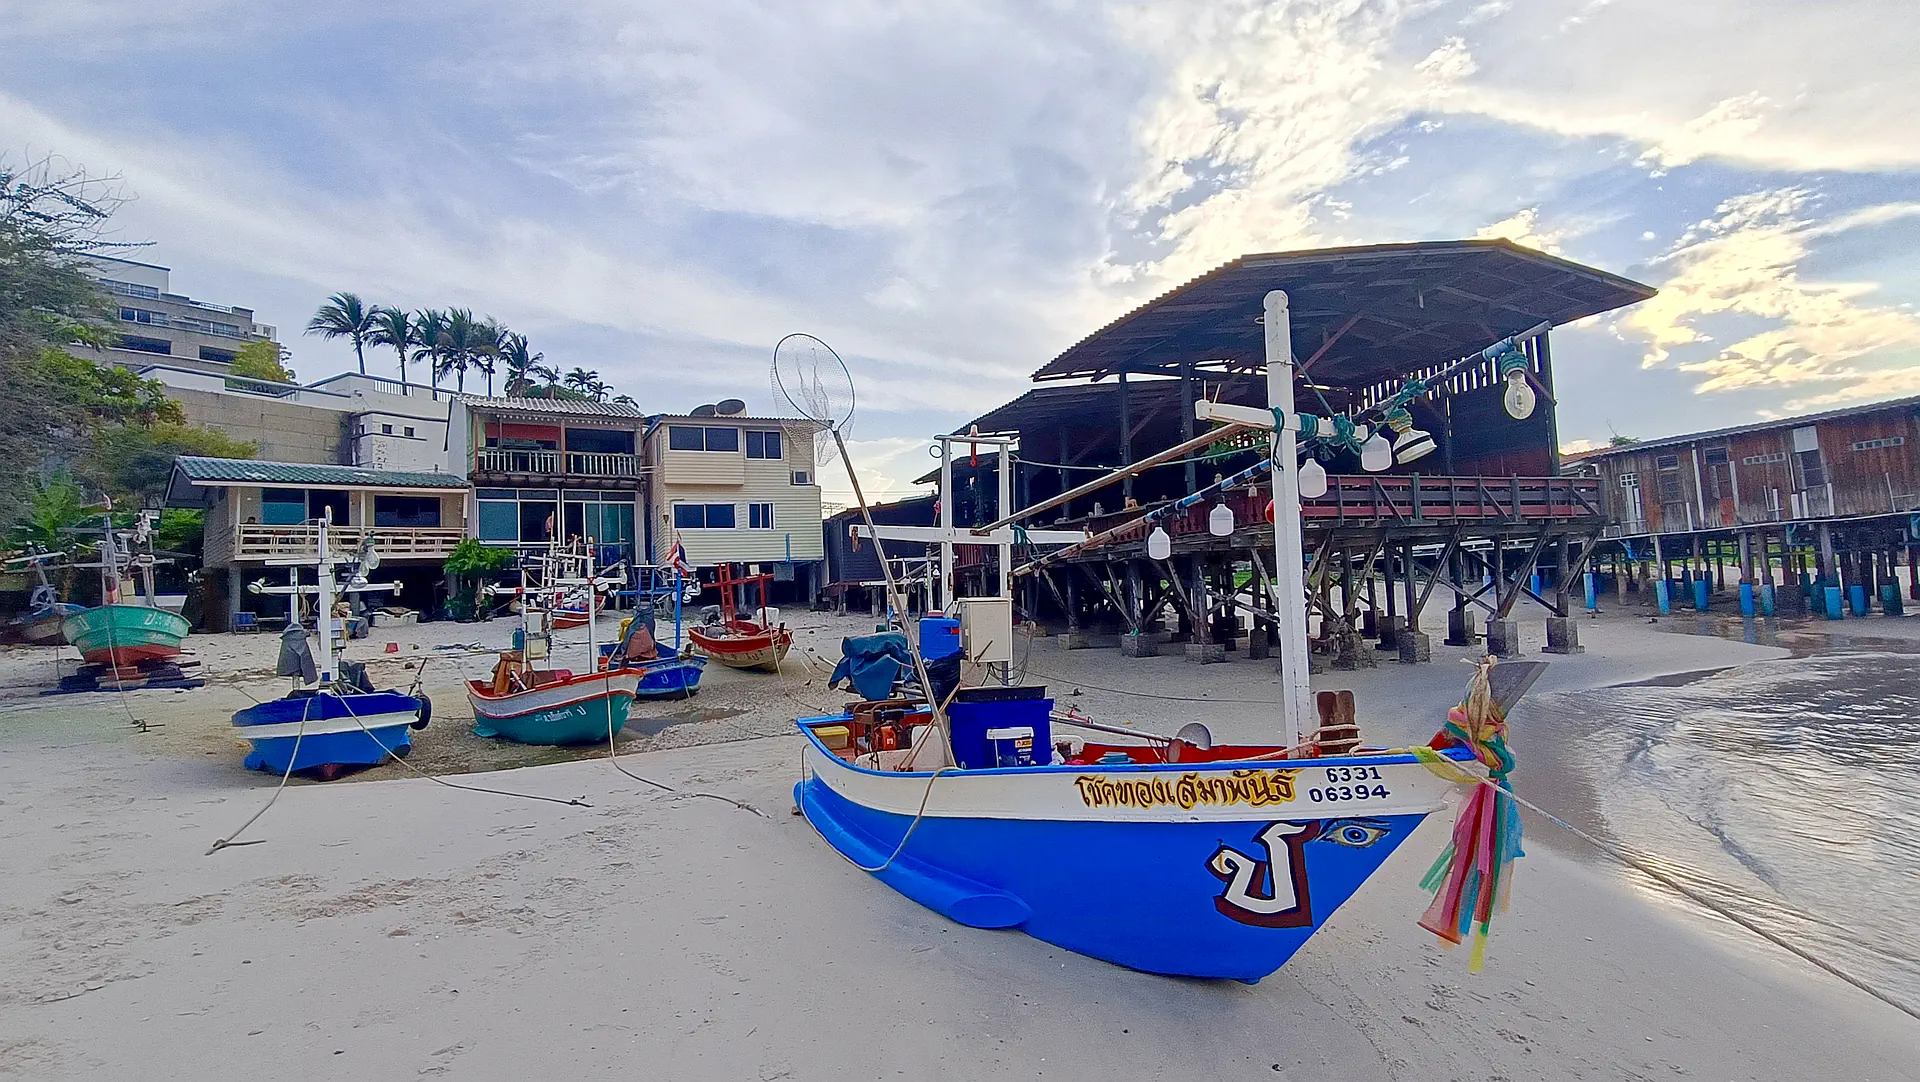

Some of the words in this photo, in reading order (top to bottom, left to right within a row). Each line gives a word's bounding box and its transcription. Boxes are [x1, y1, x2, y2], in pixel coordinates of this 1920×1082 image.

[576, 705, 587, 716] ป
[1325, 766, 1383, 784] 6331
[1309, 784, 1392, 803] 06394
